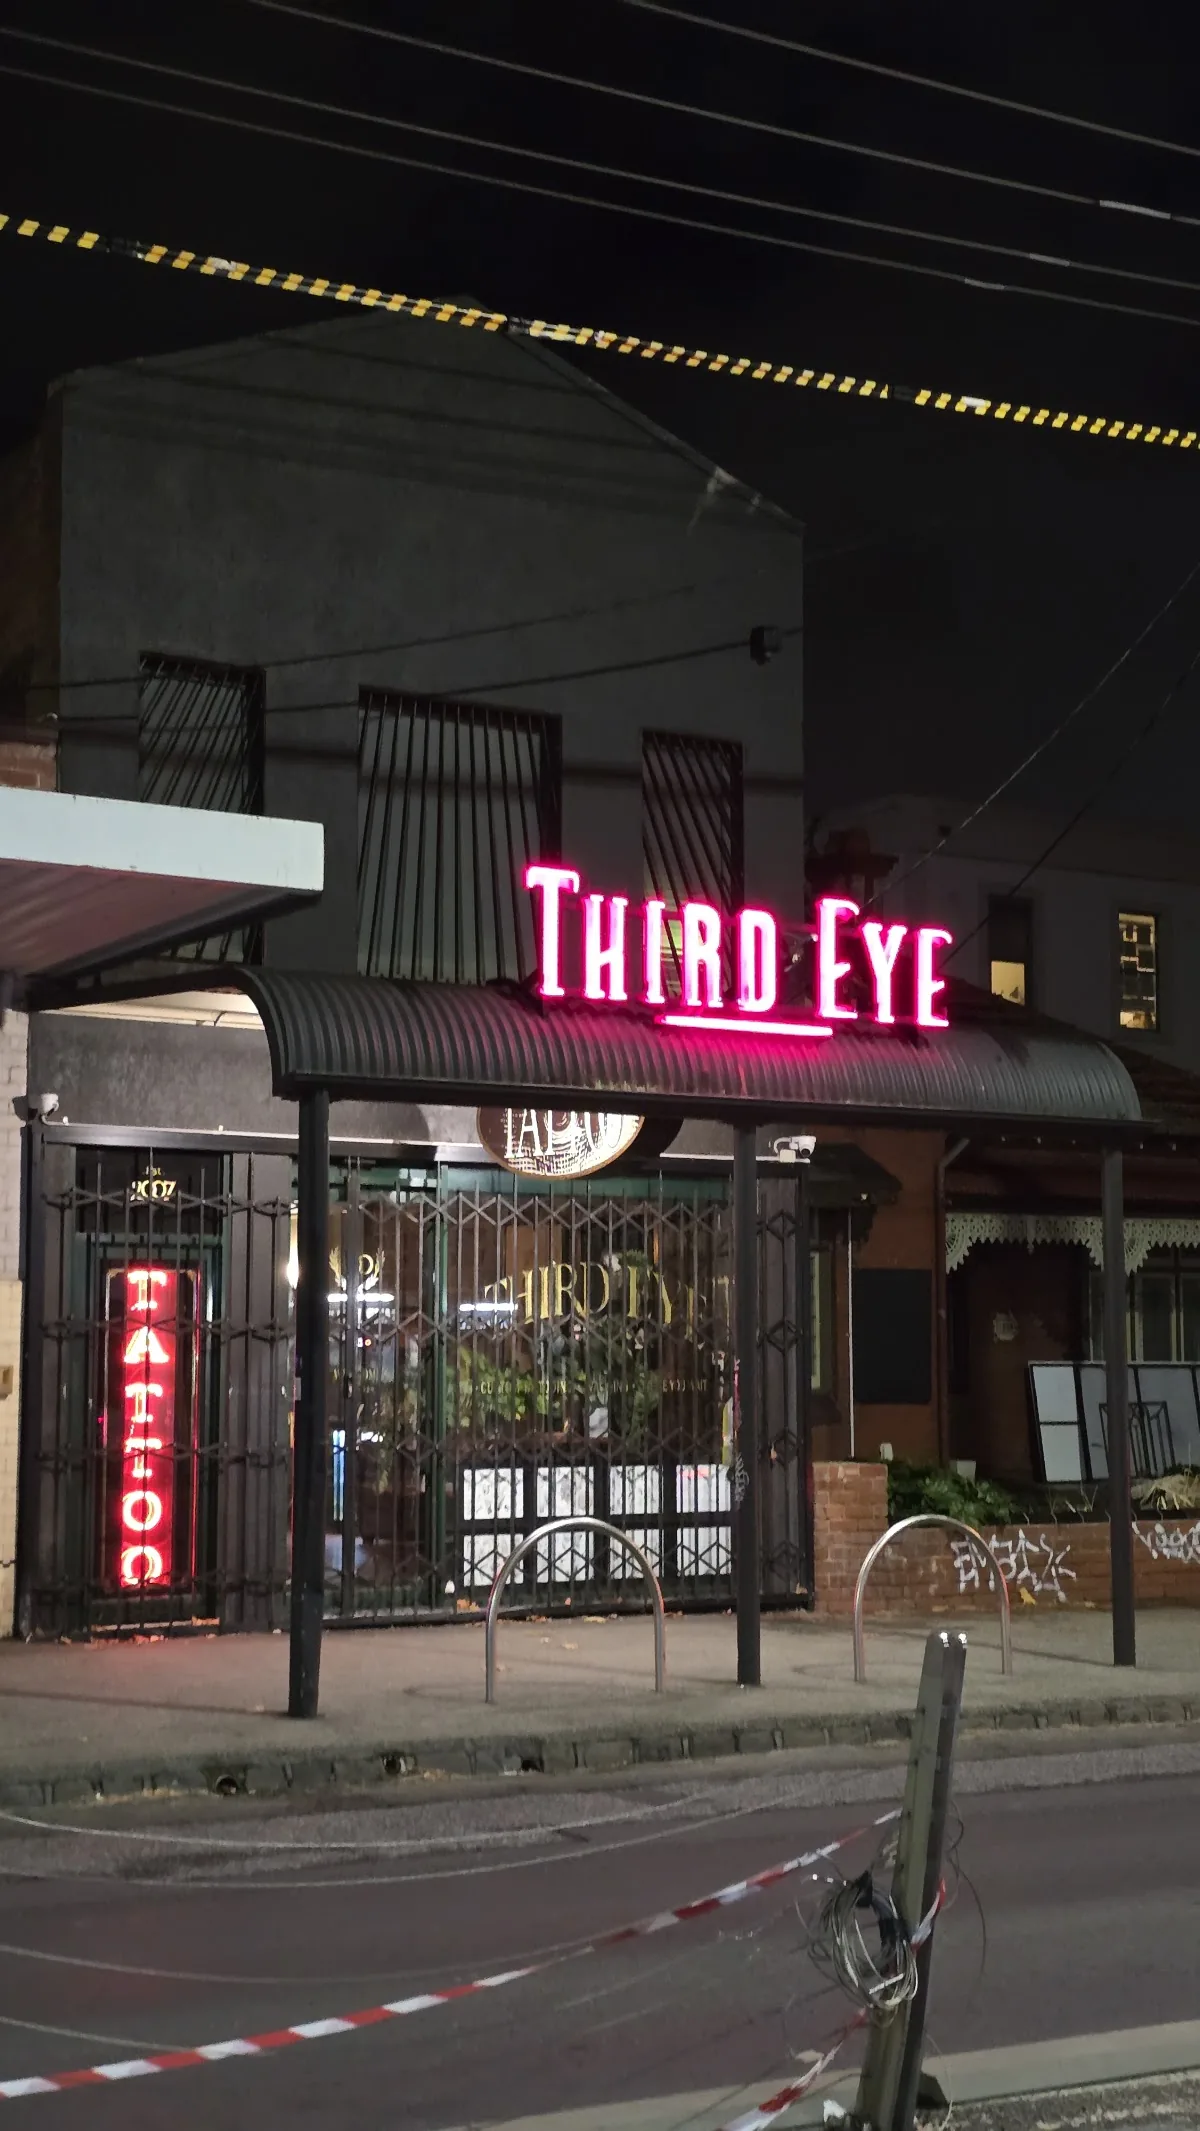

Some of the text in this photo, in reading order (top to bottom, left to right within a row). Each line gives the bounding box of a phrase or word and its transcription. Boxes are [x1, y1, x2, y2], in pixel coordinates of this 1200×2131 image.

[525, 866, 953, 1027] THIRD EYE
[122, 1270, 170, 1586] TATTOO
